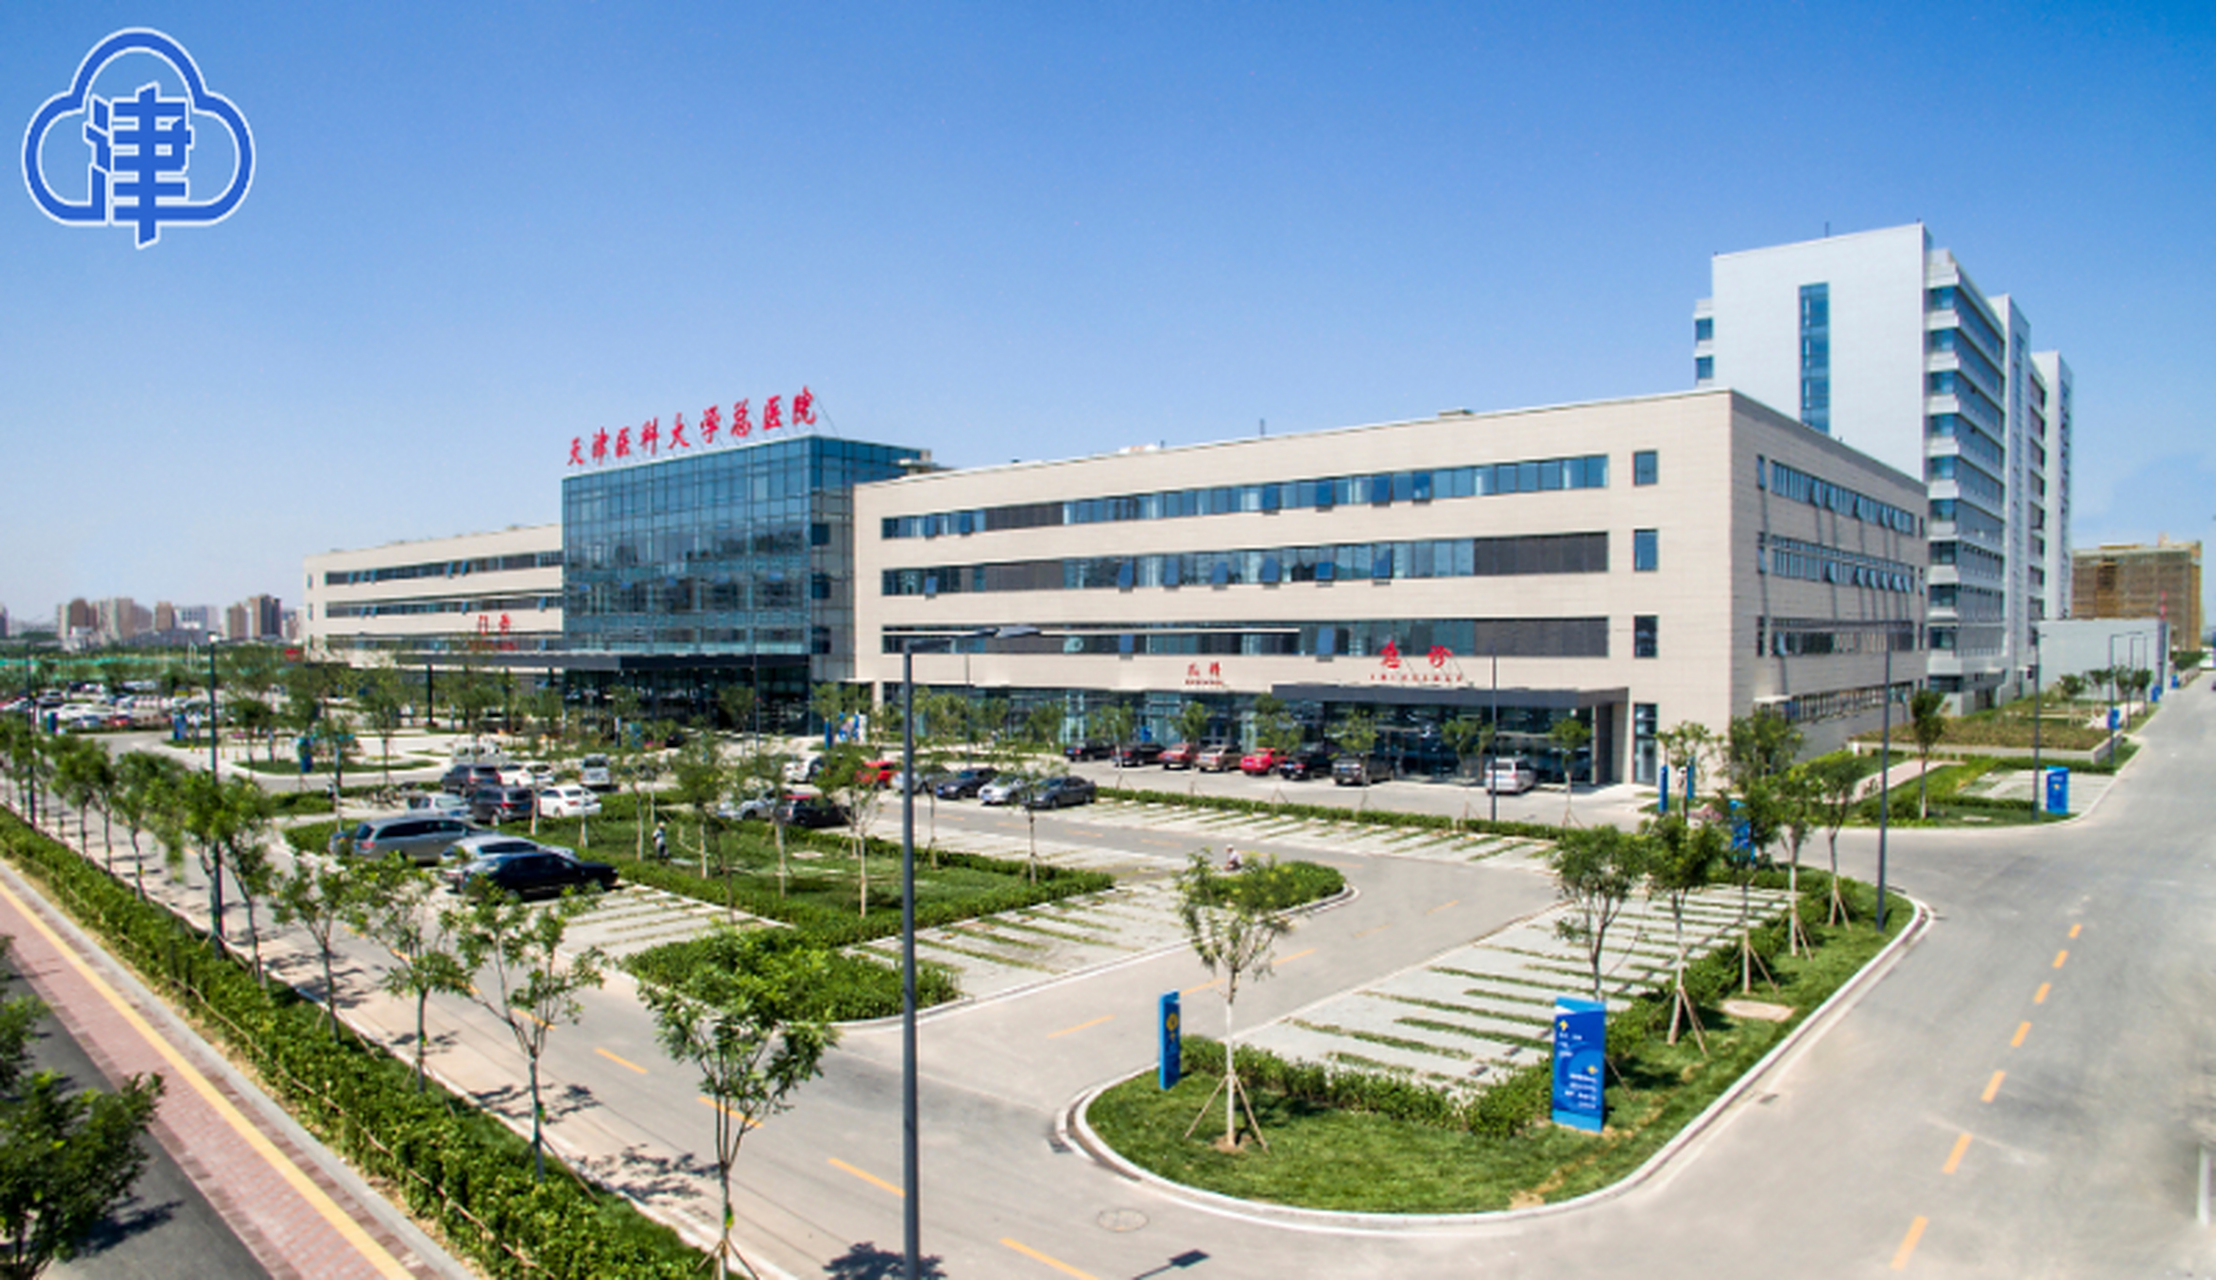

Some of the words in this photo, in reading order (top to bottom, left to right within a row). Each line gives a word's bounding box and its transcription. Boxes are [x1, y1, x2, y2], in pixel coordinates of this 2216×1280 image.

[567, 385, 816, 466] 天津医科大学总医院
[1379, 639, 1454, 669] 急诊
